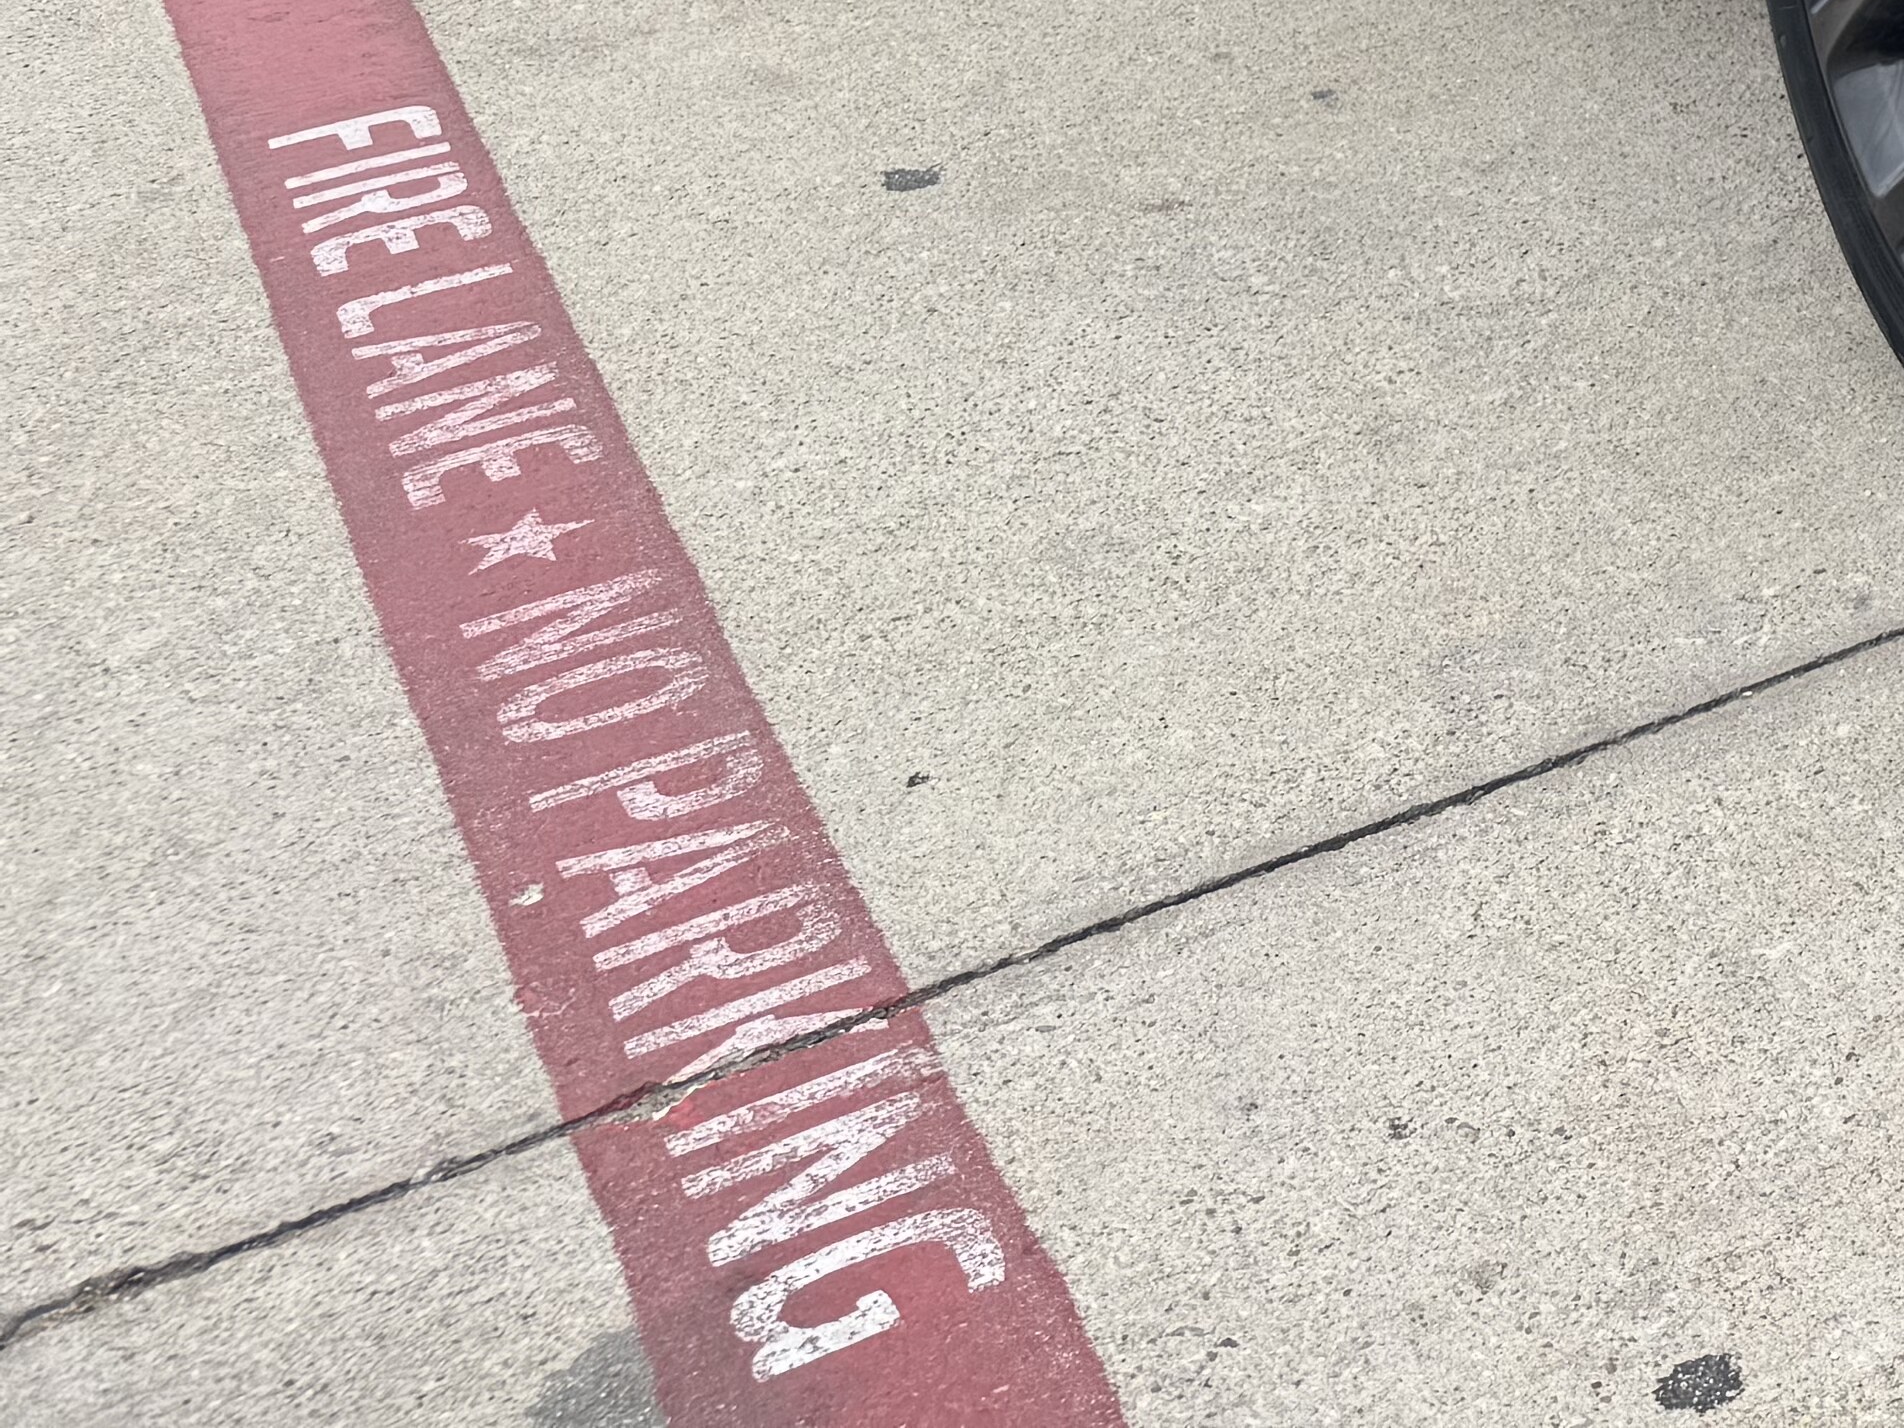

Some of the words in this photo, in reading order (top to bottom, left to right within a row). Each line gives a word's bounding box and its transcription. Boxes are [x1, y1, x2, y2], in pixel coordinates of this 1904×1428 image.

[267, 105, 493, 277] FIRE
[335, 260, 603, 510] LANE
[458, 567, 710, 745] NO
[527, 727, 1007, 1384] PARKING
